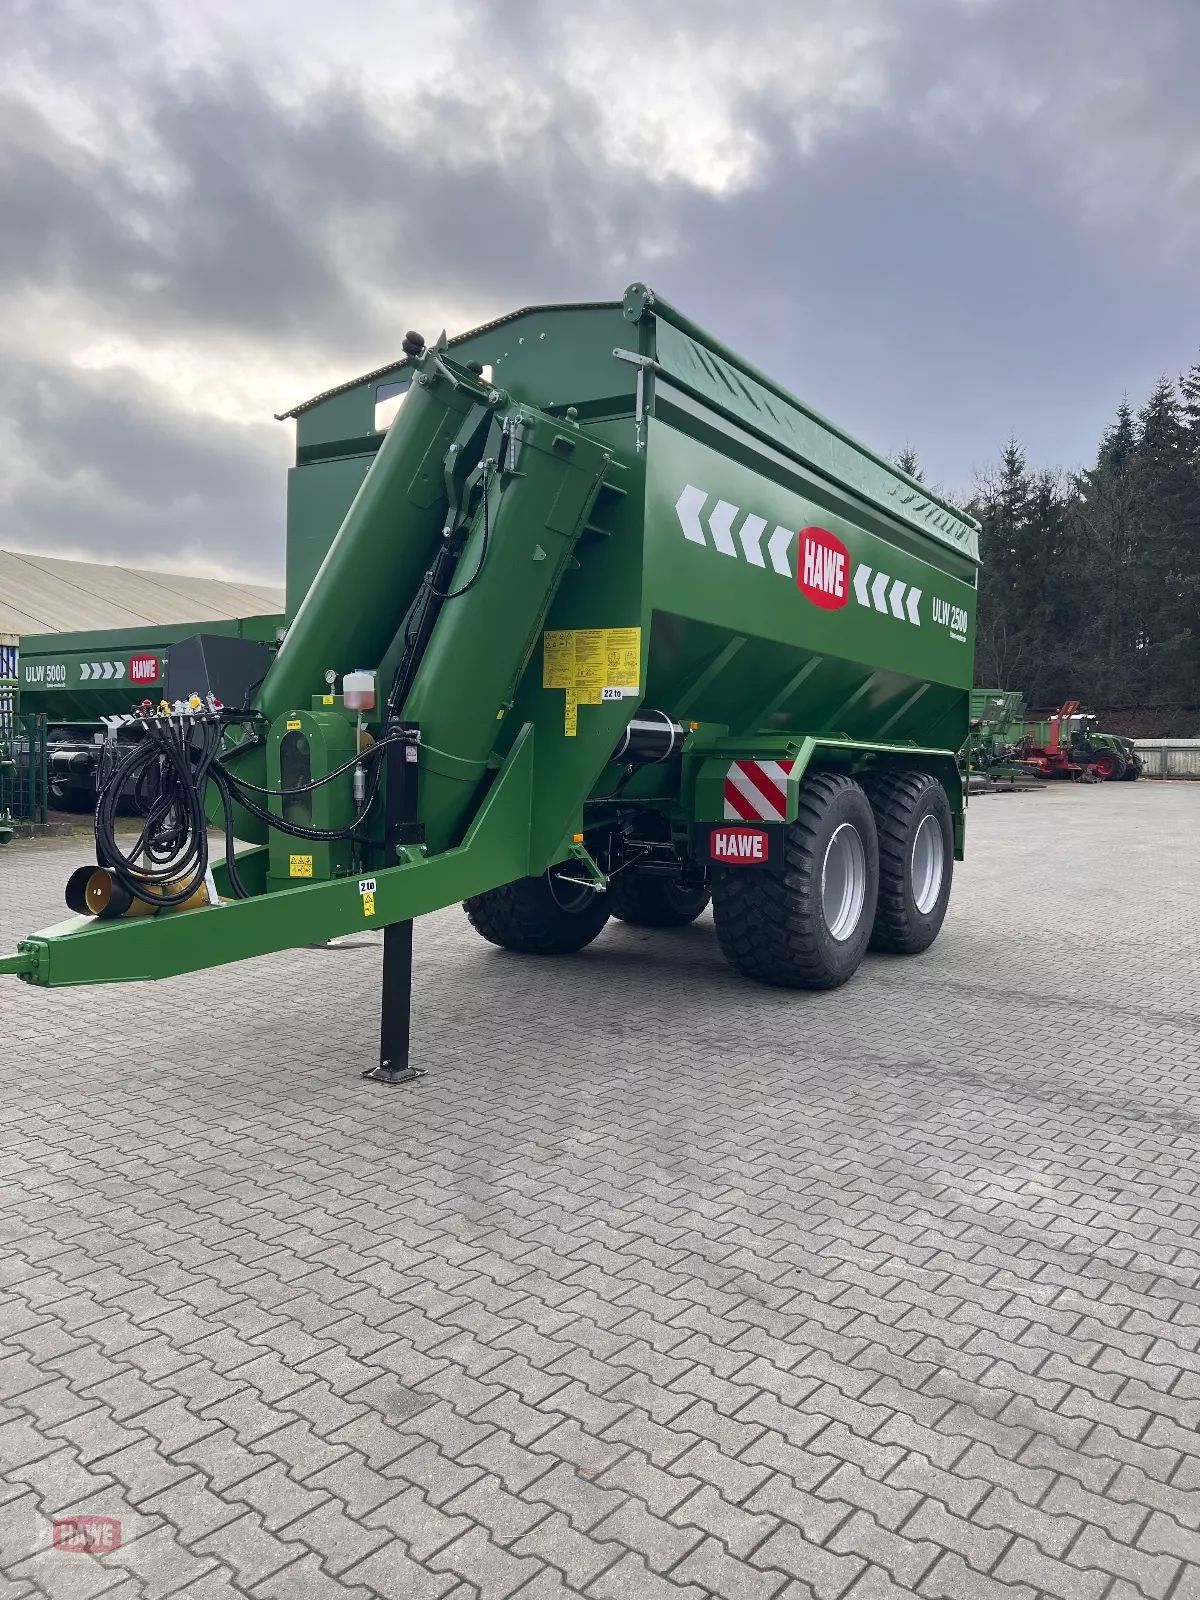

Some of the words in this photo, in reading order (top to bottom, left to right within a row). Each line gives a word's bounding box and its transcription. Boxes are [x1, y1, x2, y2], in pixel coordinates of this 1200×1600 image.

[803, 538, 845, 598] HAWE
[932, 596, 951, 626] ULW
[950, 605, 968, 634] 2500
[25, 665, 45, 682] ULW
[46, 664, 66, 682] 5000
[132, 660, 155, 678] HAWE
[604, 689, 613, 698] 22
[614, 689, 621, 698] to
[715, 833, 763, 858] HAWE
[360, 882, 366, 892] 2
